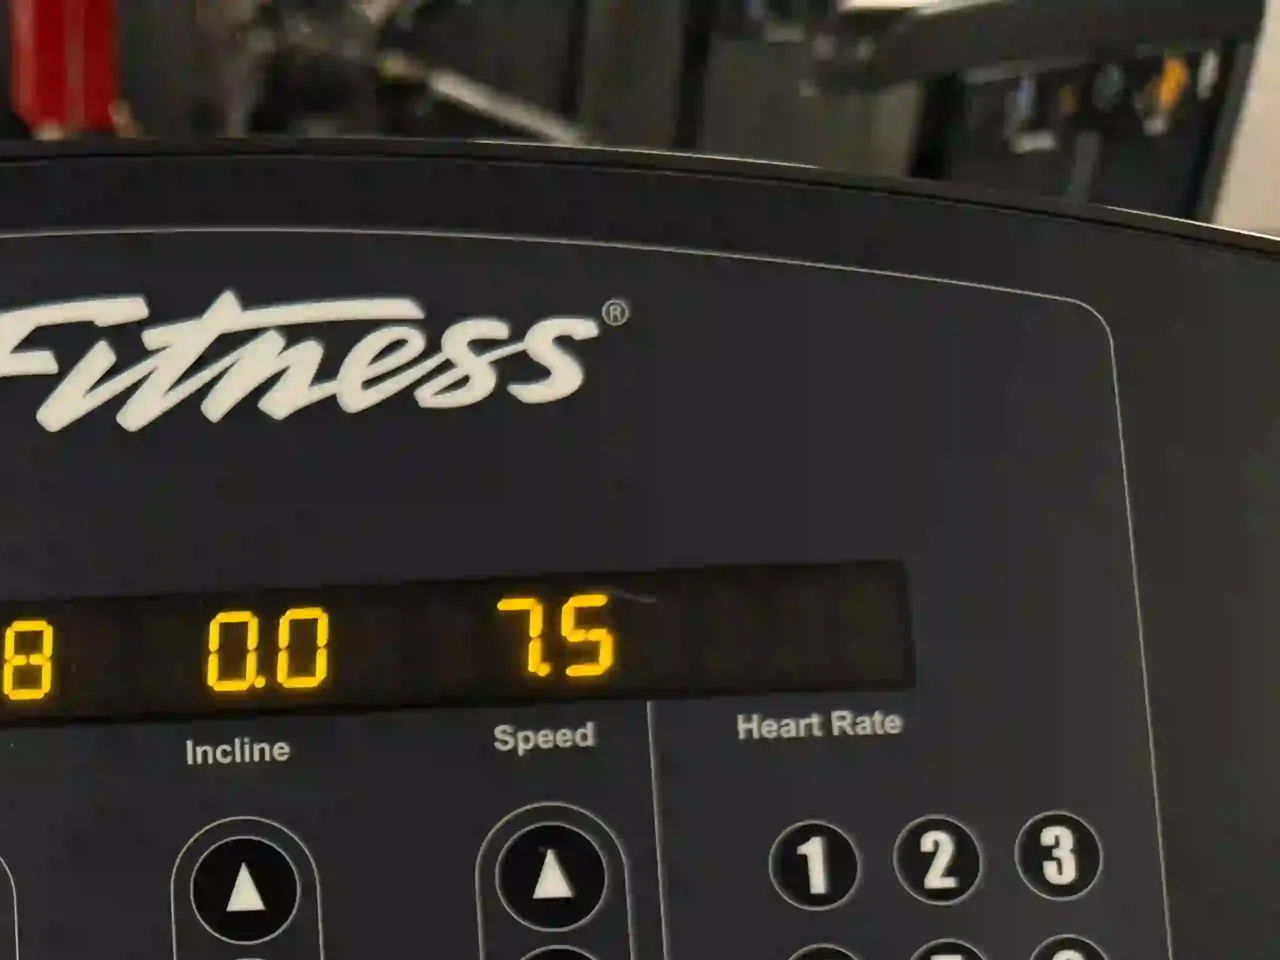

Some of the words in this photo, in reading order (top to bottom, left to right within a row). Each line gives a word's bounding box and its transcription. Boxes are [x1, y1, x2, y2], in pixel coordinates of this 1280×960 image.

[207, 607, 329, 692] 0.0
[497, 594, 616, 678] 7.5
[185, 736, 290, 767] Incline
[493, 722, 595, 756] Speed
[736, 712, 822, 740] Heart
[831, 709, 903, 737] Rate
[796, 836, 828, 895] 1
[919, 830, 959, 890] 2
[1039, 825, 1078, 885] 3
